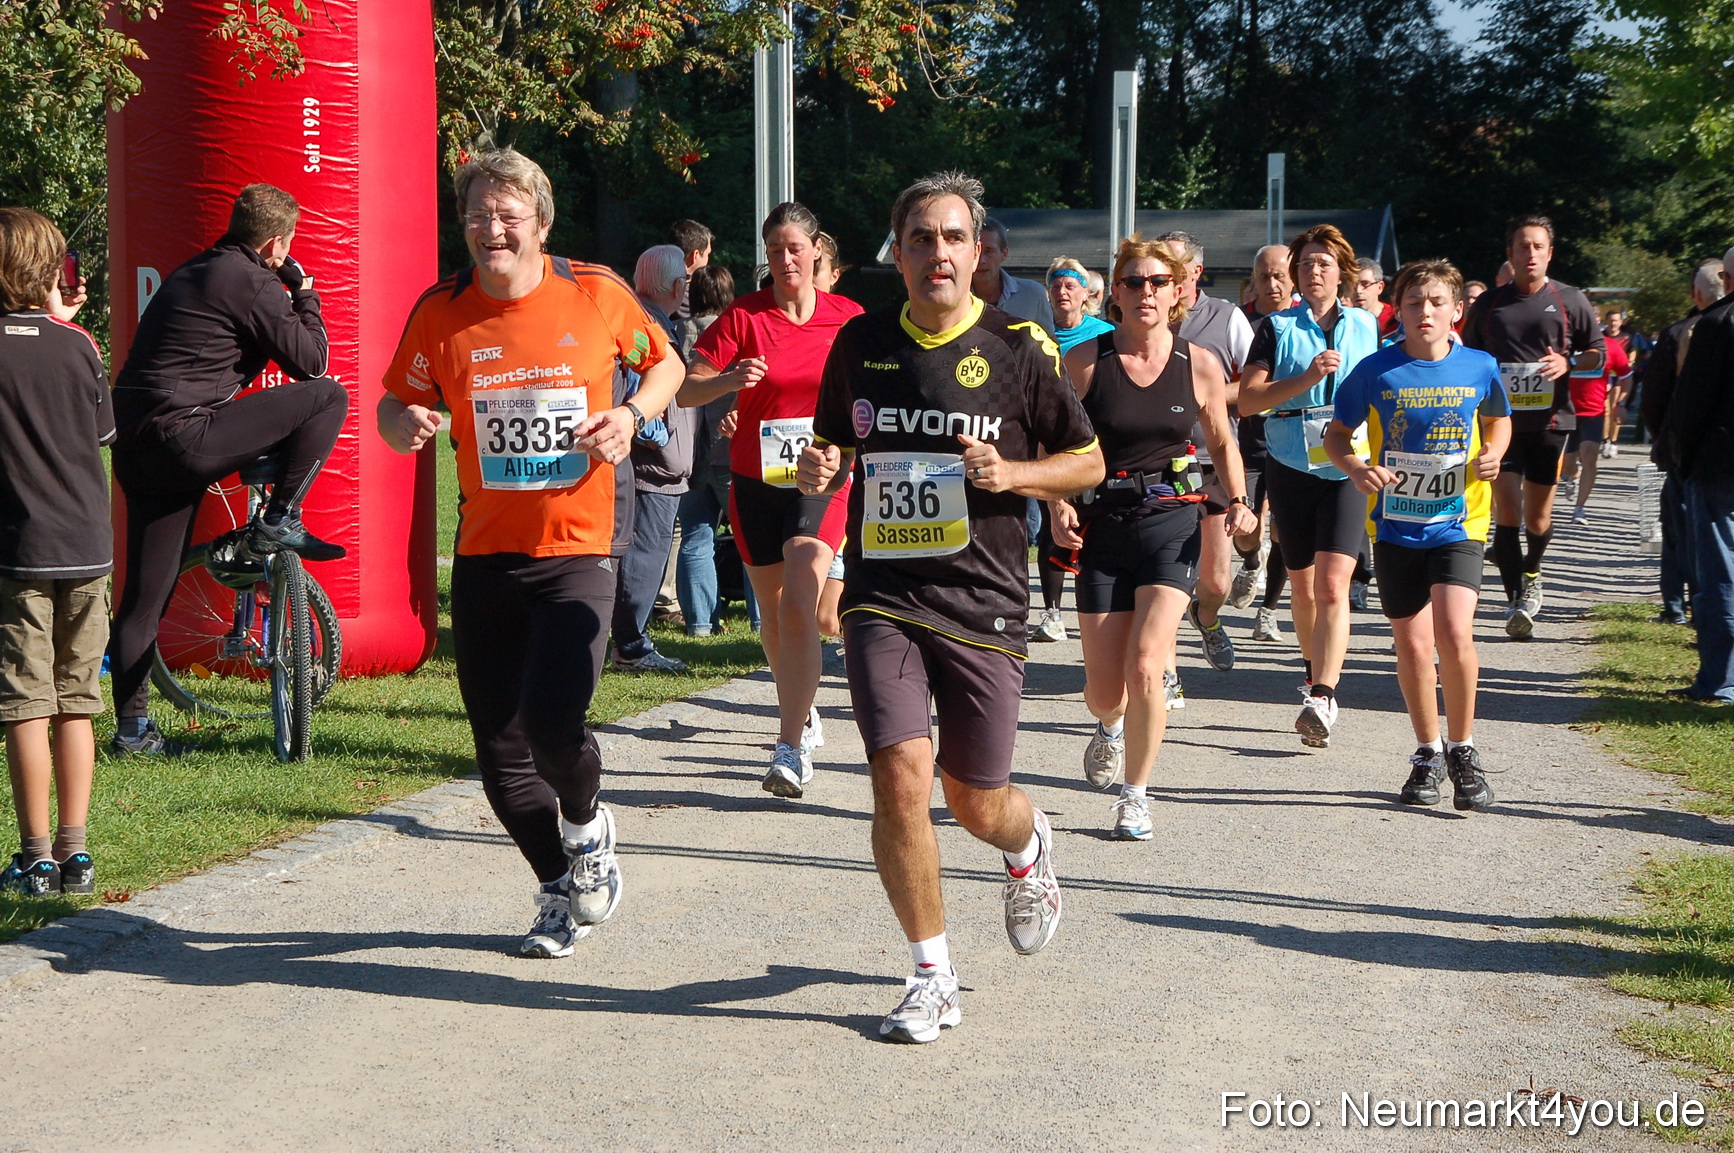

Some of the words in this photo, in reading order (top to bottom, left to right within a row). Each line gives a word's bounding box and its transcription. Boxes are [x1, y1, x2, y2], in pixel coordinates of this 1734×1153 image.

[302, 97, 320, 137] 1929
[303, 143, 321, 173] Seit
[863, 360, 900, 371] Kappa
[960, 360, 985, 378] BVB
[261, 368, 283, 389] ist
[472, 362, 573, 388] SportScheck
[1510, 375, 1543, 393] 312
[524, 380, 554, 391] Stadtlauf
[555, 379, 574, 388] 2009
[1380, 389, 1396, 401] 10.
[1398, 386, 1477, 399] NEUMARKTER
[488, 399, 536, 409] PFLEIDERER
[1396, 397, 1463, 409] STADTLAUF
[1510, 394, 1543, 406] Jürgen
[876, 407, 1002, 441] EVONIK
[486, 415, 575, 454] 3335
[779, 436, 810, 463] 43
[504, 457, 563, 477] Albert
[874, 461, 914, 472] PFLEIDERER
[1397, 458, 1433, 467] PFLEIDERER
[785, 467, 797, 480] In
[1393, 470, 1457, 498] 2740
[878, 480, 941, 520] 536
[1391, 497, 1457, 514] Johannes
[876, 523, 945, 545] Sassan
